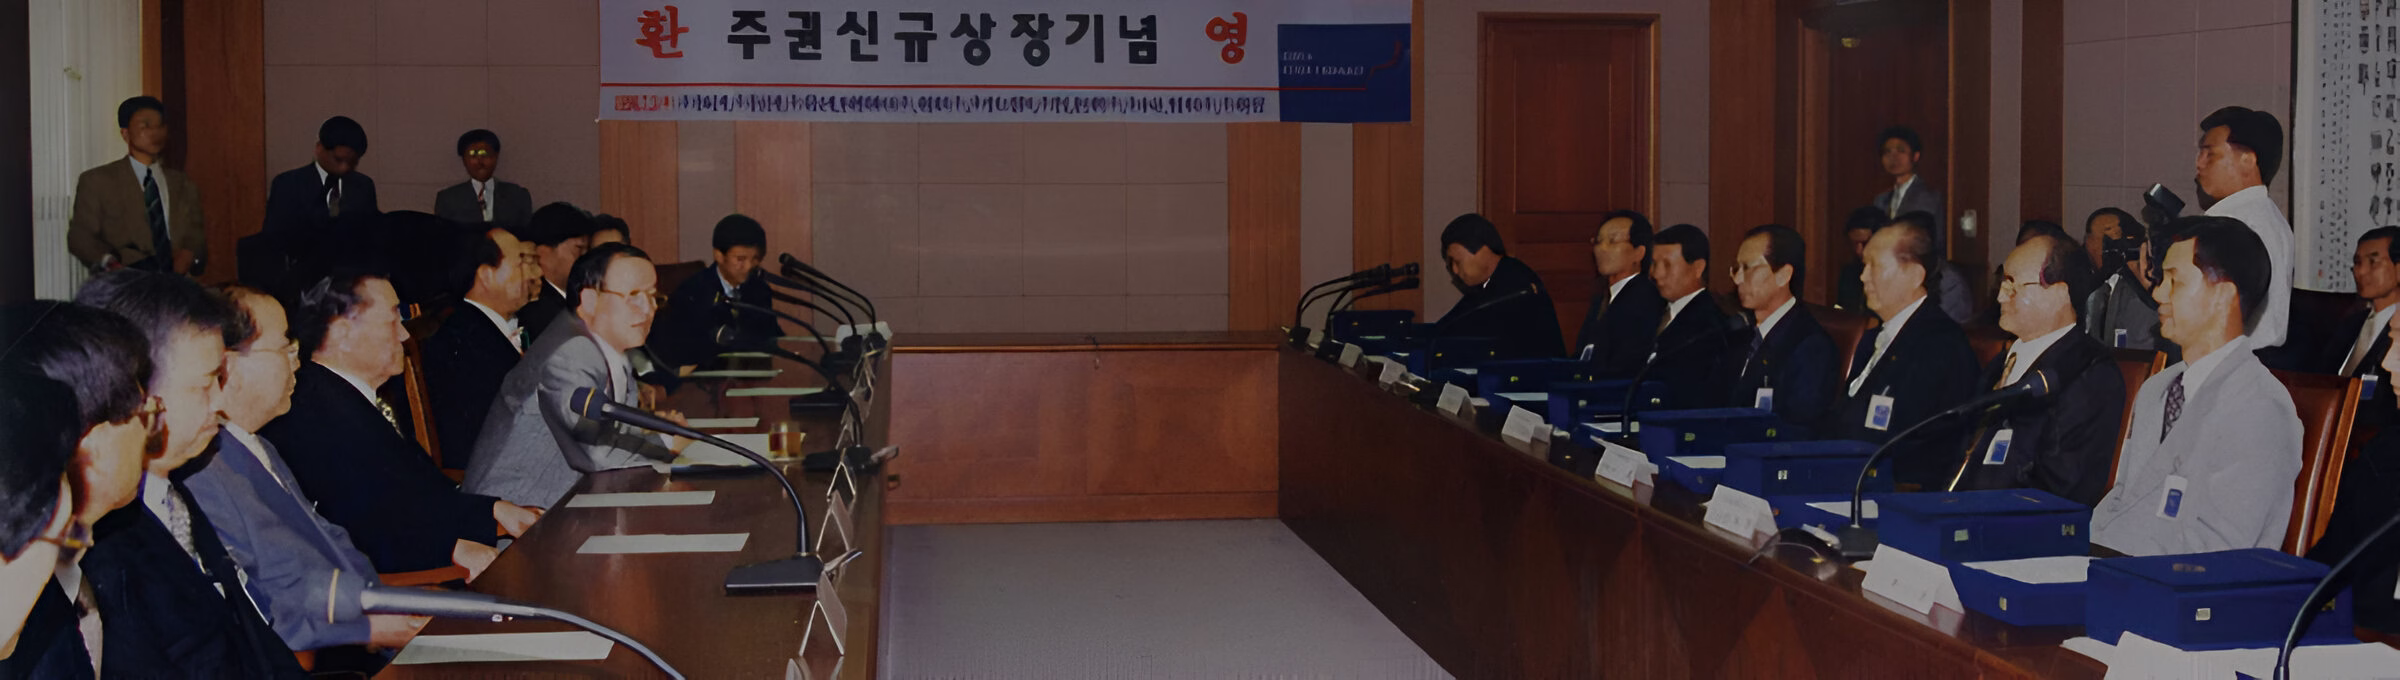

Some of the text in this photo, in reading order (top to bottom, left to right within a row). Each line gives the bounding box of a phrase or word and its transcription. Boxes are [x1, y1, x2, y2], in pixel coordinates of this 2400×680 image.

[635, 5, 1248, 67] 환 주권신규상장기념 영
